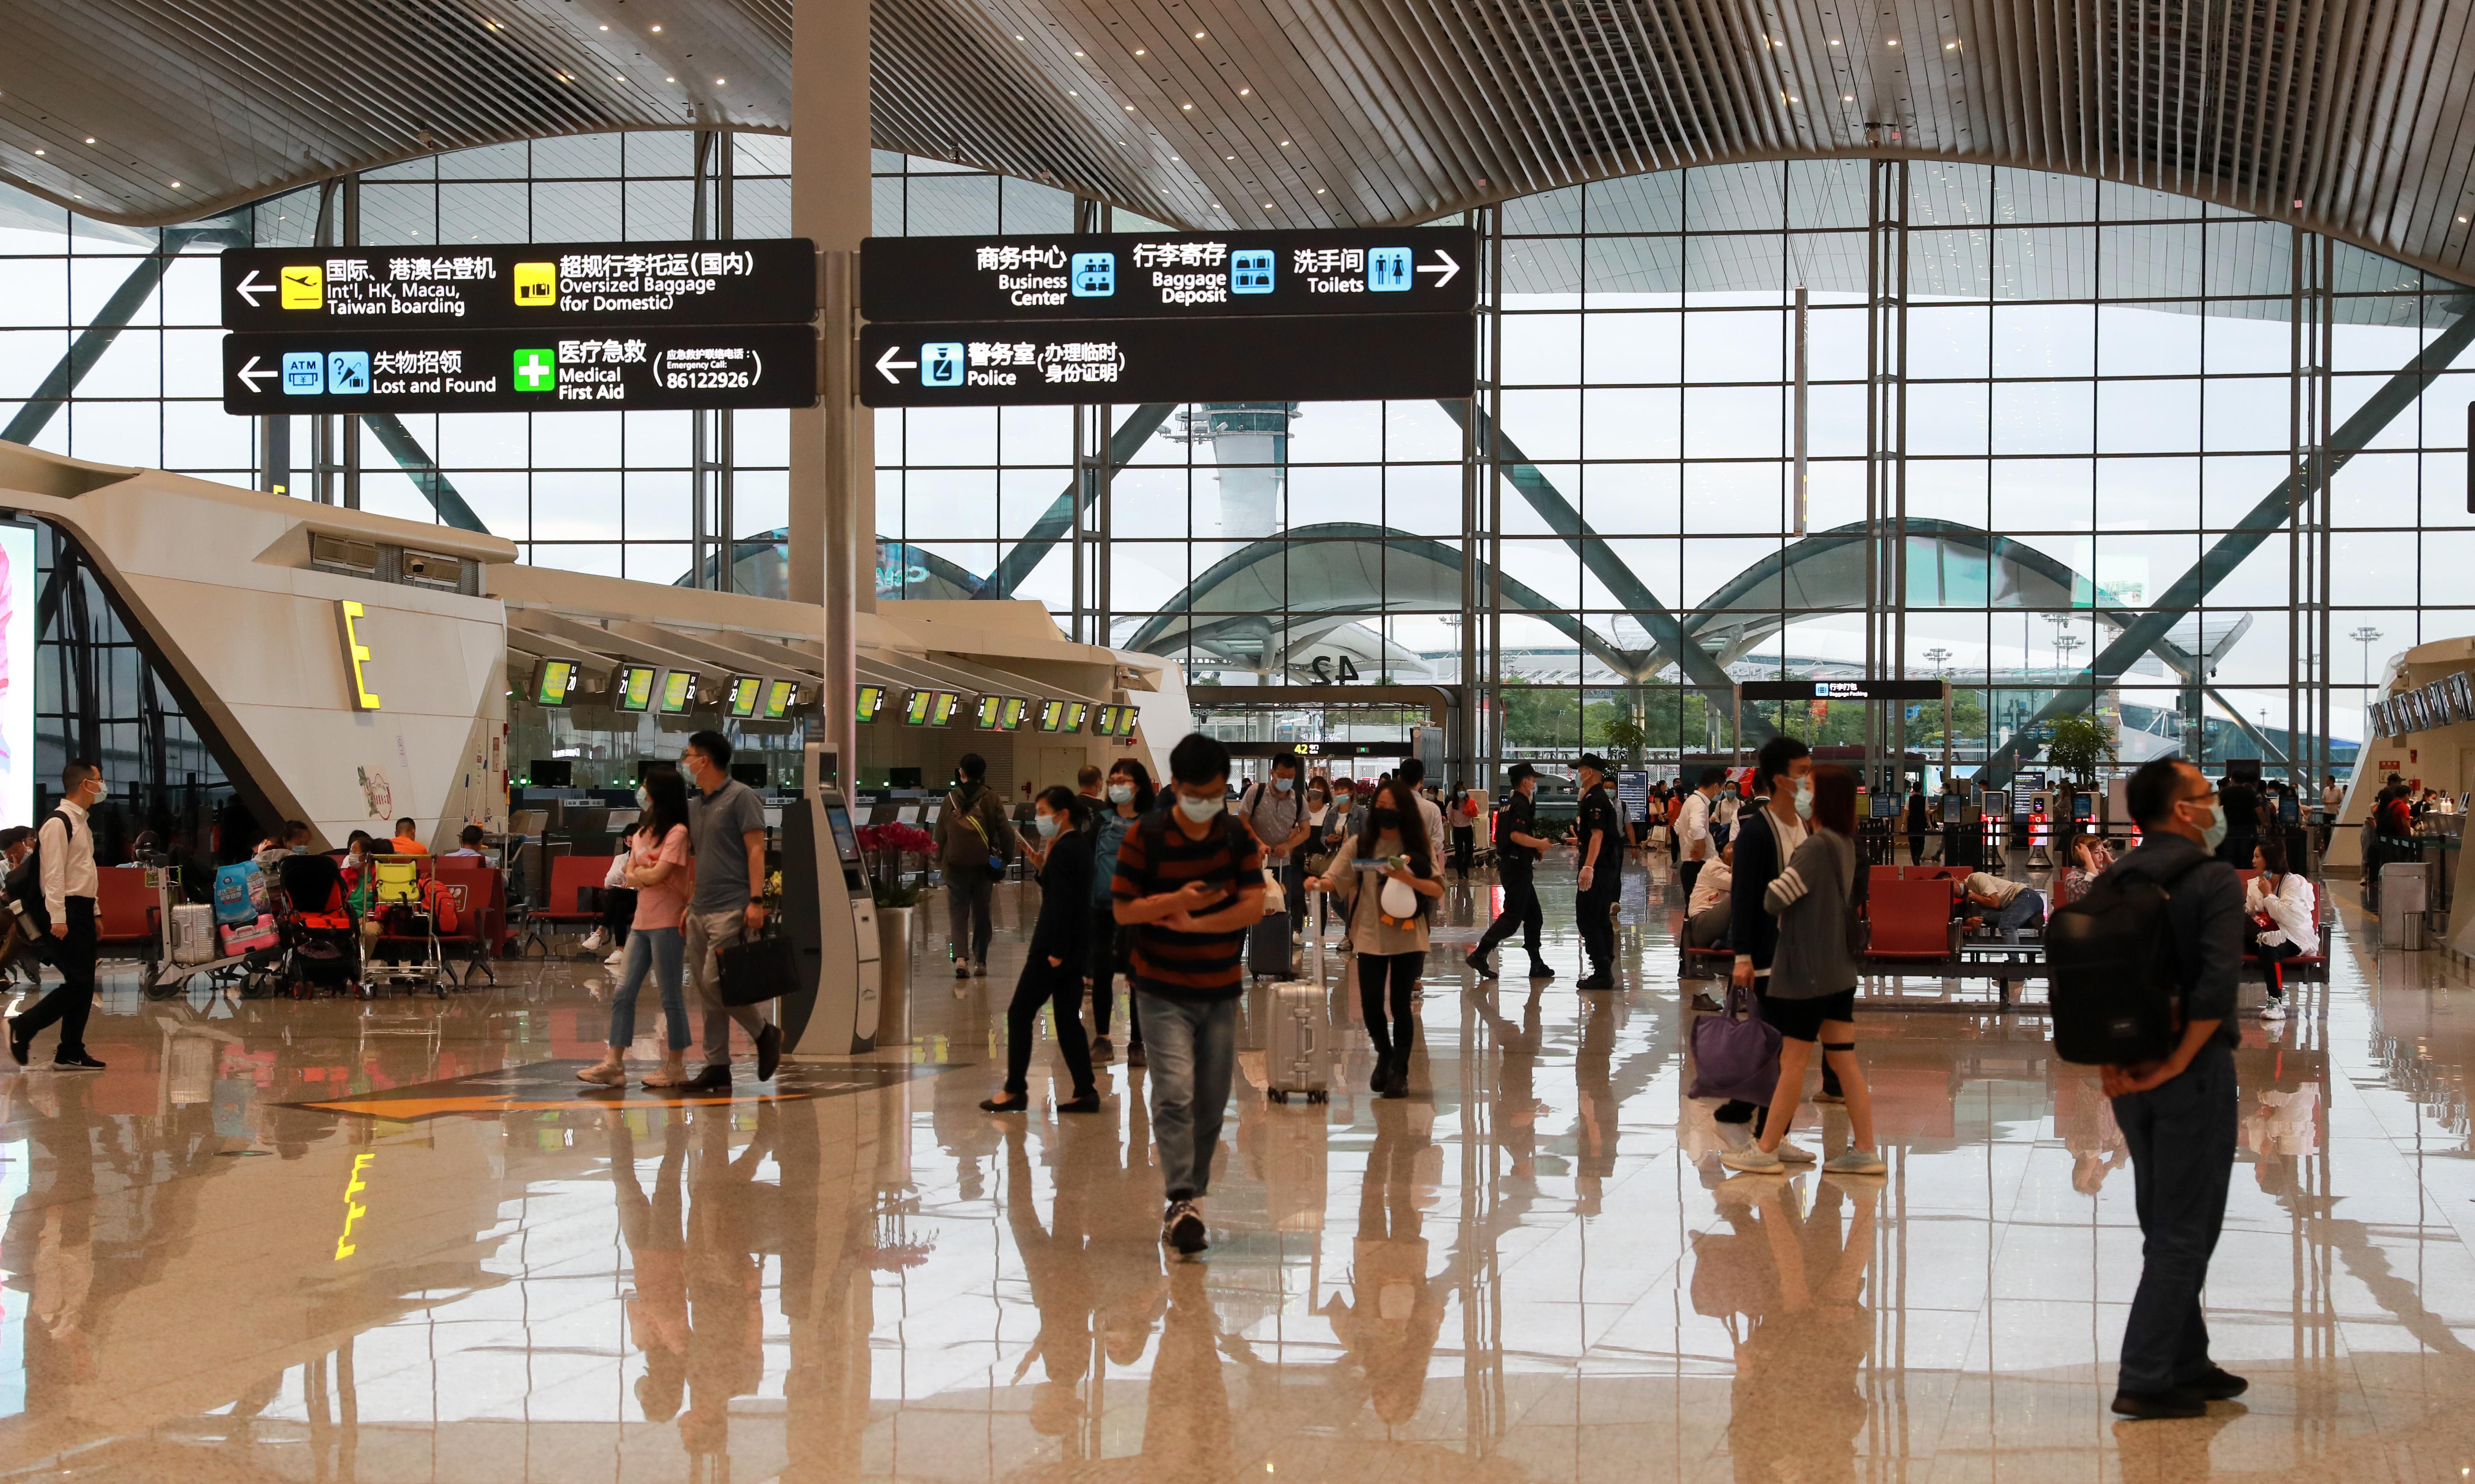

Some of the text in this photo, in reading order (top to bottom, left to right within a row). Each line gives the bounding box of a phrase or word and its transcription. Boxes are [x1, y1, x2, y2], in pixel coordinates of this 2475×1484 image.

[976, 244, 1067, 271] 商务中心
[1133, 241, 1227, 268] 行李寄存
[1293, 248, 1364, 274] 洗手间
[326, 256, 497, 282] 国际、港澳台登机
[560, 277, 716, 295] Oversized Baggage
[999, 274, 1067, 289] Business
[1152, 271, 1227, 289] Baggage
[1307, 277, 1364, 293] Toilets
[327, 283, 460, 300] Int'l, HK, Macau,
[1011, 290, 1068, 306] Center
[1162, 289, 1227, 307] Deposit
[327, 298, 465, 317] Taiwan Boarding
[560, 294, 674, 312] (for Domestic)
[559, 339, 647, 364] 医疗急救
[968, 341, 1036, 367] 警务室
[1044, 341, 1118, 363] 办理临时
[290, 361, 316, 370] ATM
[373, 350, 462, 375] 失物招领
[667, 360, 727, 371] Emergency Call:
[559, 367, 621, 383] Medical
[667, 372, 749, 389] 86122926
[967, 369, 1017, 386] Police
[1045, 363, 1118, 384] 身份证明
[373, 376, 496, 394] Lost and Found
[559, 383, 625, 400] First Aid
[341, 600, 380, 710] E
[567, 676, 577, 691] 20
[619, 679, 628, 694] 21
[1829, 683, 1858, 691] 行李打包
[686, 686, 696, 699] 22
[729, 688, 738, 702] 23
[787, 693, 796, 706] 24
[1294, 744, 1308, 754] 42
